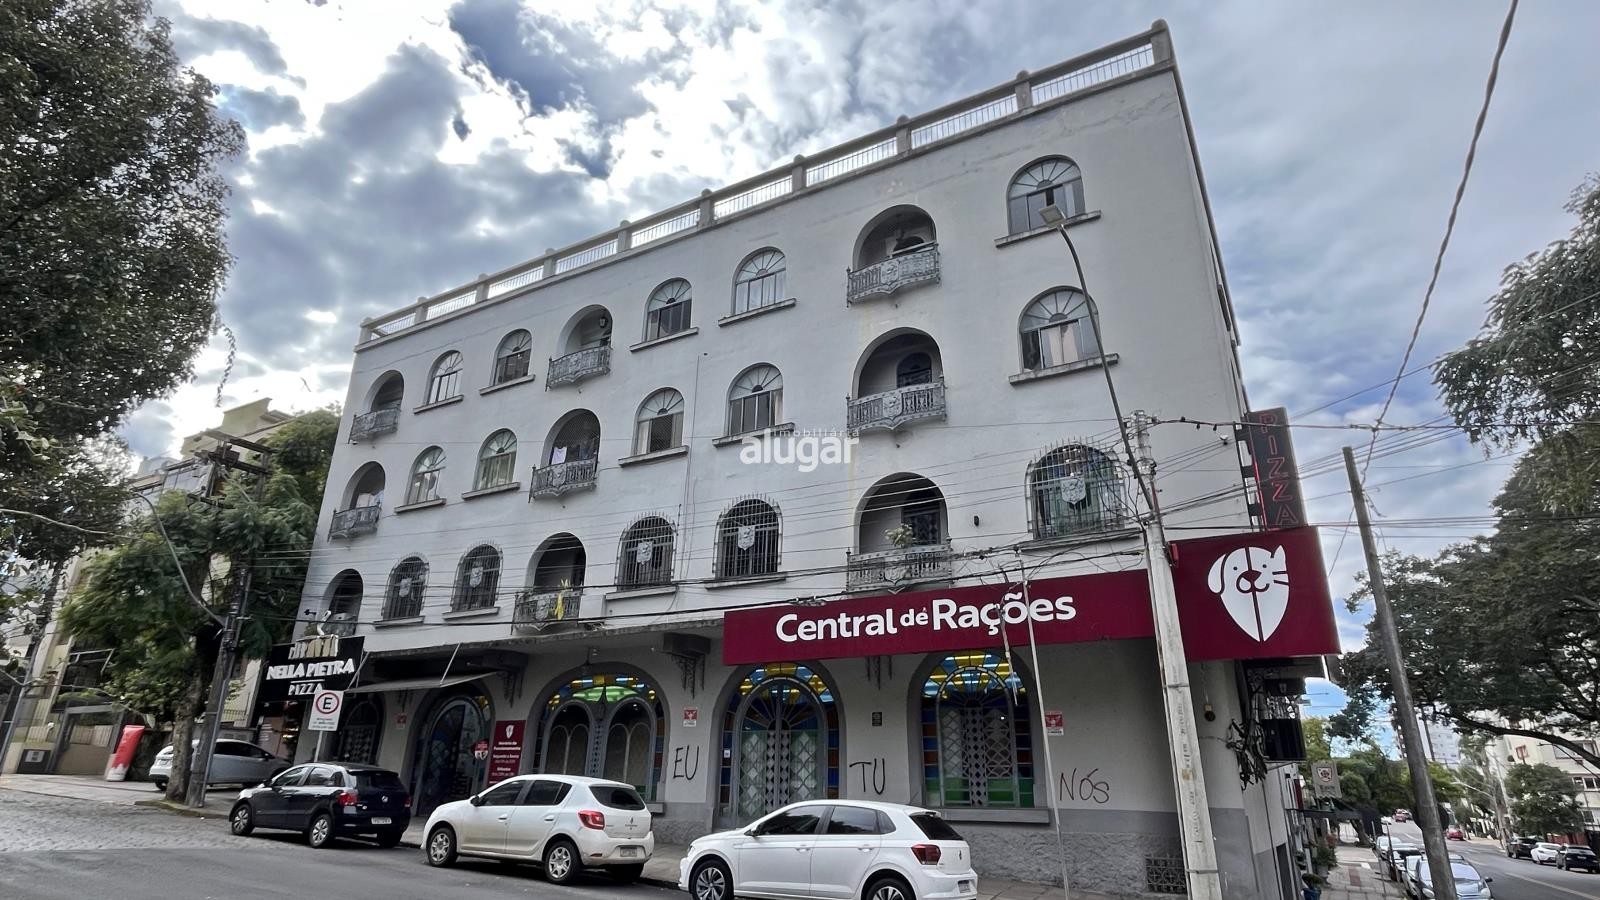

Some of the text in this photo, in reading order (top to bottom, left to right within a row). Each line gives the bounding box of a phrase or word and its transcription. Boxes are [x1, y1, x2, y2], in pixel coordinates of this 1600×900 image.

[1259, 413, 1298, 526] PIZZA
[775, 608, 898, 643] Central
[932, 592, 1077, 636] Rações
[266, 658, 355, 680] NELLA PIETRA
[322, 697, 333, 710] E
[672, 745, 700, 780] EU
[849, 757, 886, 795] TU
[1060, 767, 1110, 804] NÓS
